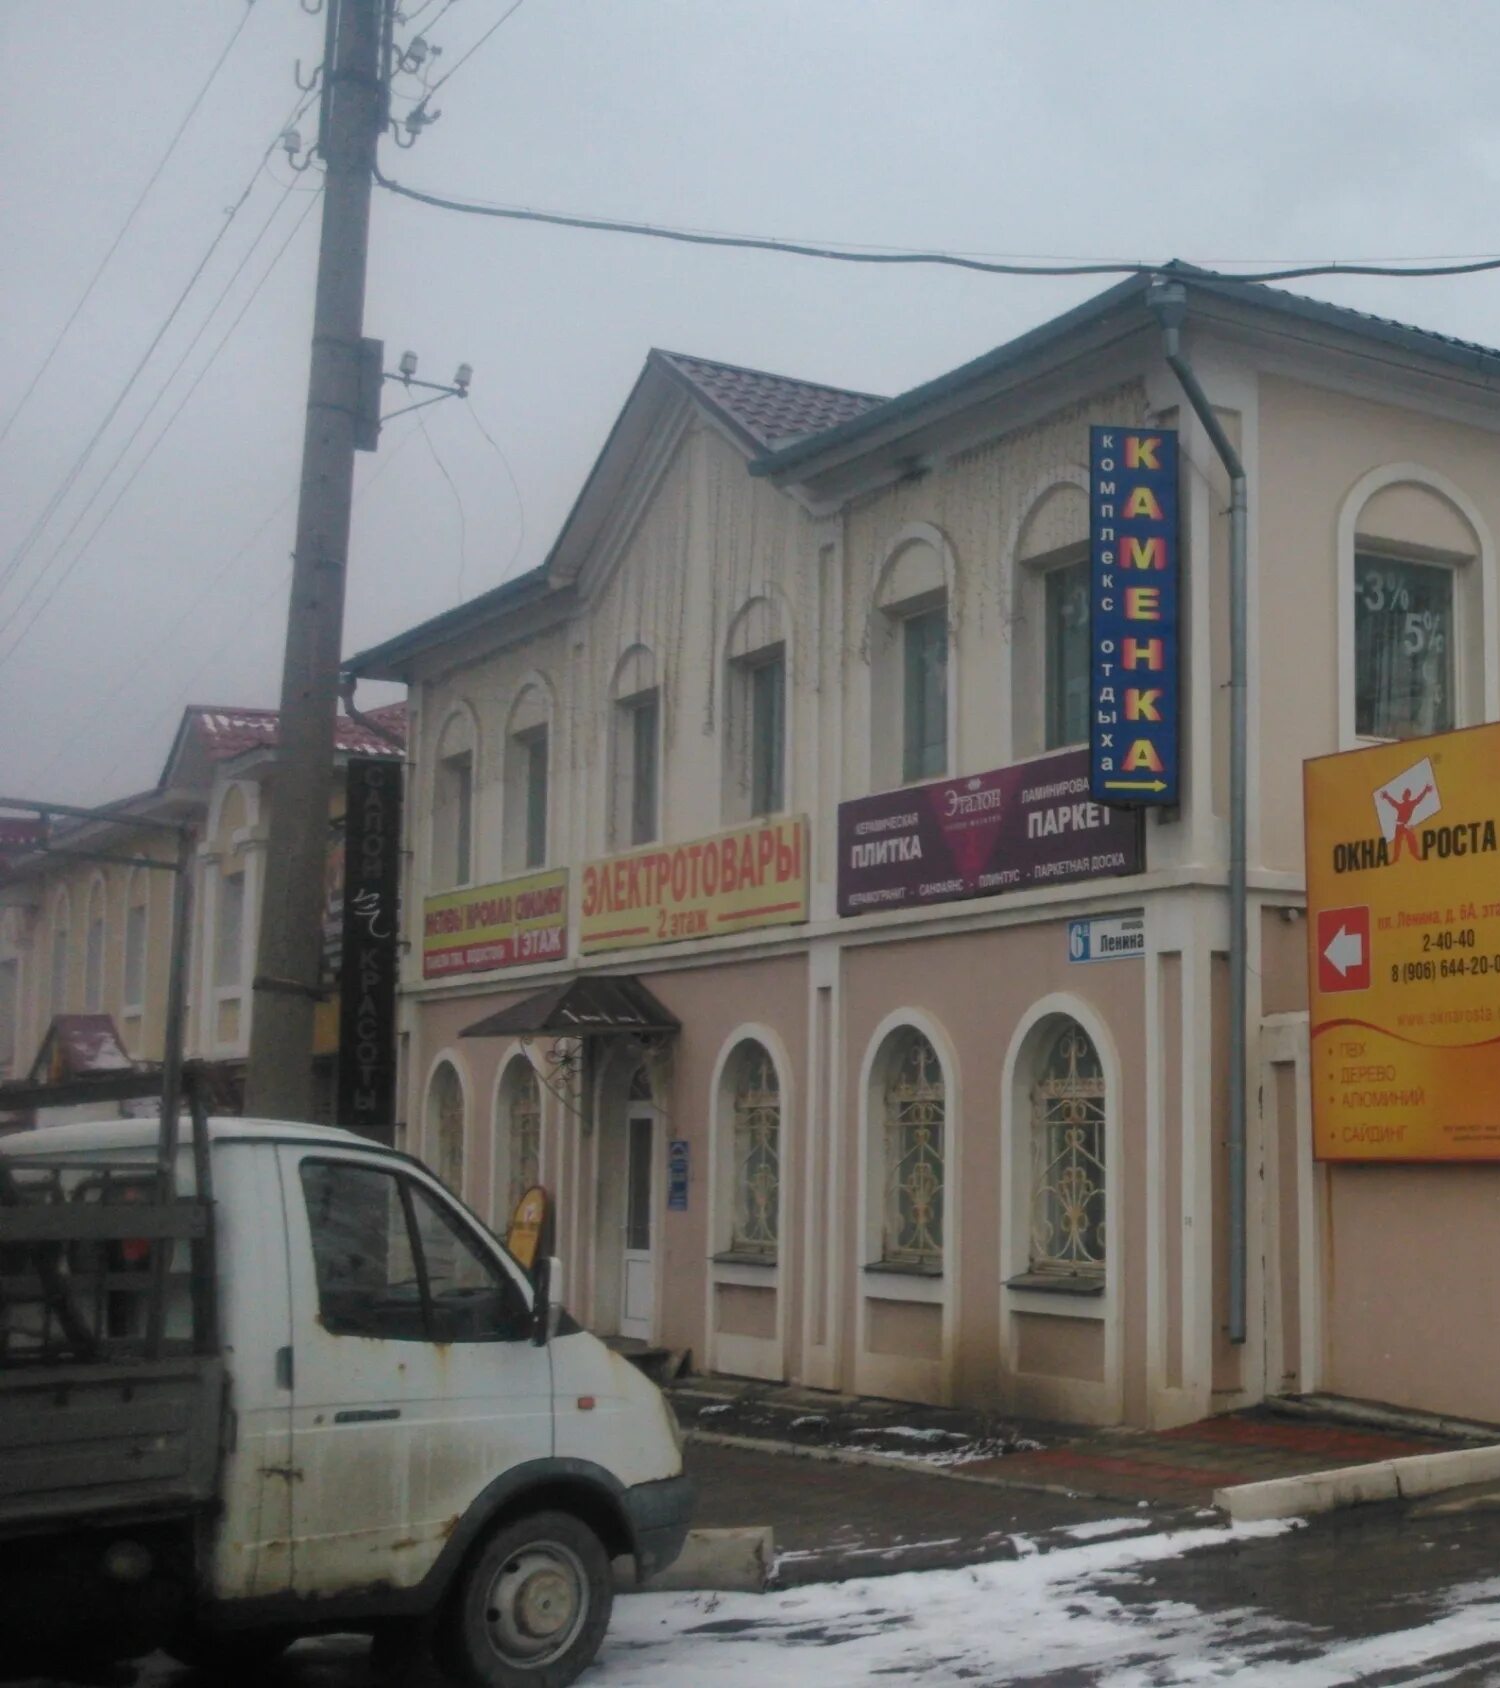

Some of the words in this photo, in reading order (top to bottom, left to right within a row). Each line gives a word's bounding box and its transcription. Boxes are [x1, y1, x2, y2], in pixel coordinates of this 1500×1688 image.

[1119, 436, 1167, 772] КАМЕНКА
[944, 788, 1001, 817] Эталон
[1021, 777, 1090, 804] ЛАМИНИРОВА
[361, 767, 385, 878] САЛОН
[851, 835, 923, 869] ПЛИТКА
[1333, 837, 1390, 874] ОКНА
[1421, 820, 1498, 861] РОСТА
[581, 822, 801, 916] ЭЛЕКТРОТОВАРЫ
[978, 868, 1020, 888] ПЛИНТУС
[1034, 858, 1090, 879] ПАРКЕТНАЯ
[1091, 852, 1126, 872] ДОСКА
[656, 912, 667, 938] 2
[670, 909, 708, 934] этаж
[521, 926, 561, 957] ЭТАЖ
[1100, 933, 1144, 952] Ленина
[1422, 929, 1475, 952] 2-40-40
[1391, 964, 1399, 982] 8
[1403, 960, 1436, 984] (906)
[355, 950, 379, 1111] КРАСОТЫ
[1340, 1042, 1366, 1058] ПВХ
[1340, 1065, 1396, 1084] ДЕРЕВО
[1342, 1086, 1425, 1108] АЛЮМИНИЙ
[1342, 1124, 1408, 1143] САЙДИНГ
